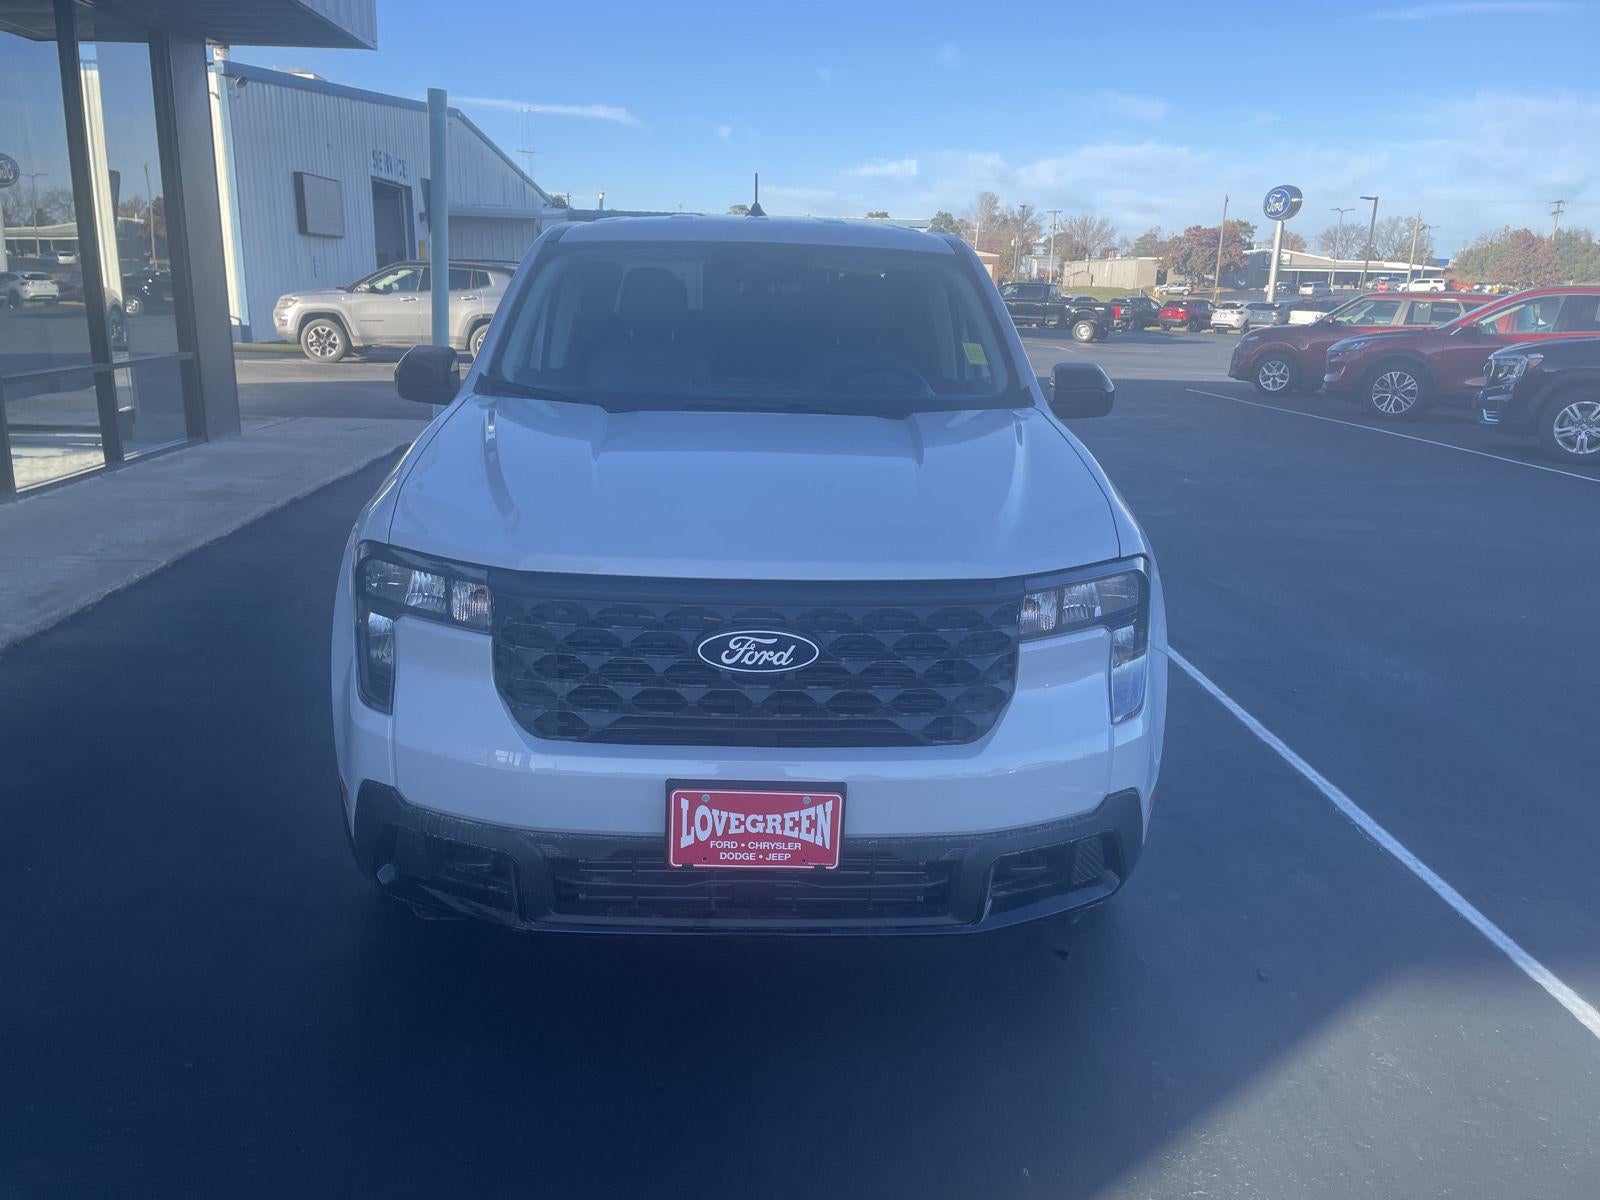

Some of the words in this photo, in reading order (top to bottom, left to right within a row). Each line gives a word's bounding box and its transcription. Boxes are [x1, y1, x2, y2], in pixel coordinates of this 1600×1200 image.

[372, 149, 408, 179] SERVCE
[1266, 193, 1286, 213] Ford
[721, 636, 796, 665] Ford
[680, 797, 833, 849] LOVEGREEN
[710, 840, 738, 849] FORD
[748, 841, 802, 851] CHRYSLER
[720, 852, 756, 861] DODGE
[765, 852, 791, 861] JEEP
